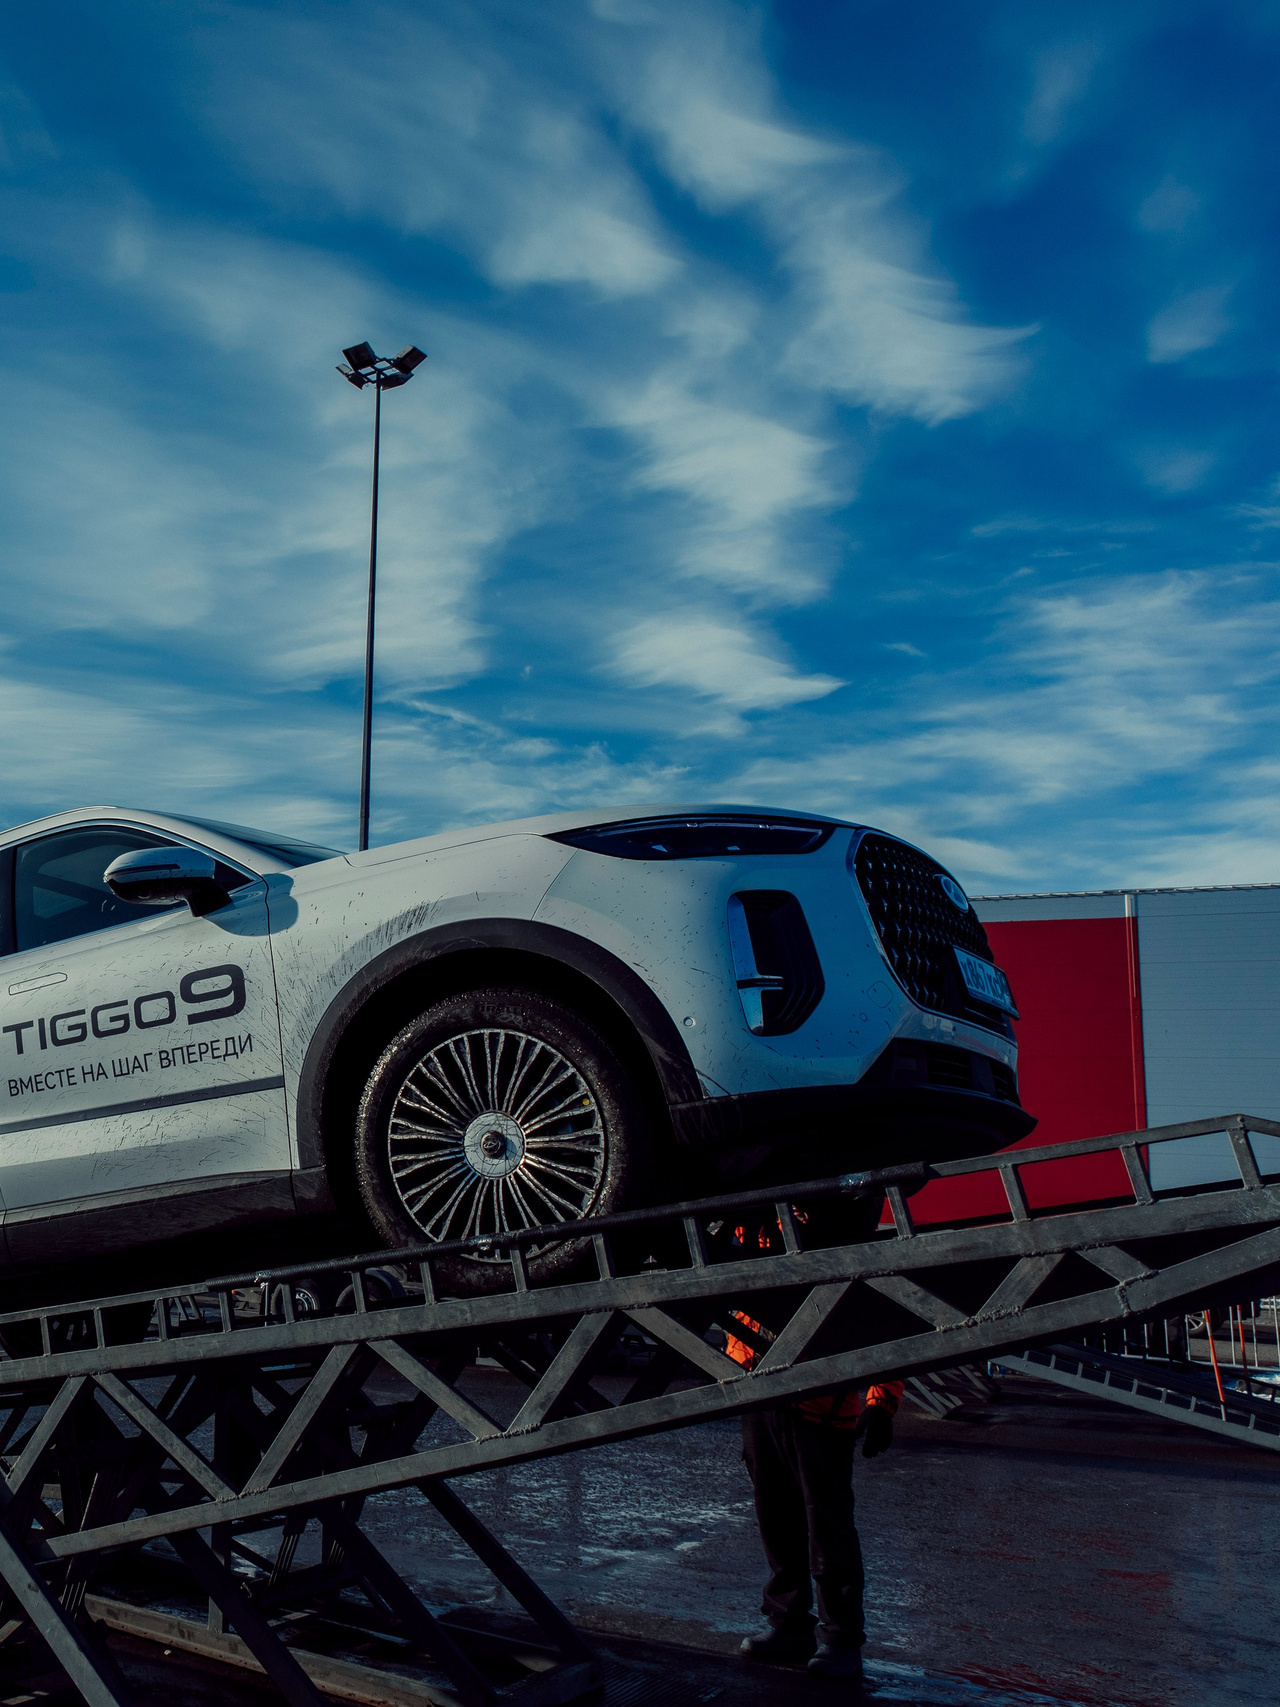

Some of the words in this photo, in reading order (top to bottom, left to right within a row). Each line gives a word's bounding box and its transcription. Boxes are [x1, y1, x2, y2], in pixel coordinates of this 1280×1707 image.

[8, 1066, 77, 1097] ВМЕСТЕ
[81, 1061, 109, 1084] НА
[111, 1052, 154, 1078] ШАГ
[158, 1033, 254, 1069] ВПЕРЕДИ
